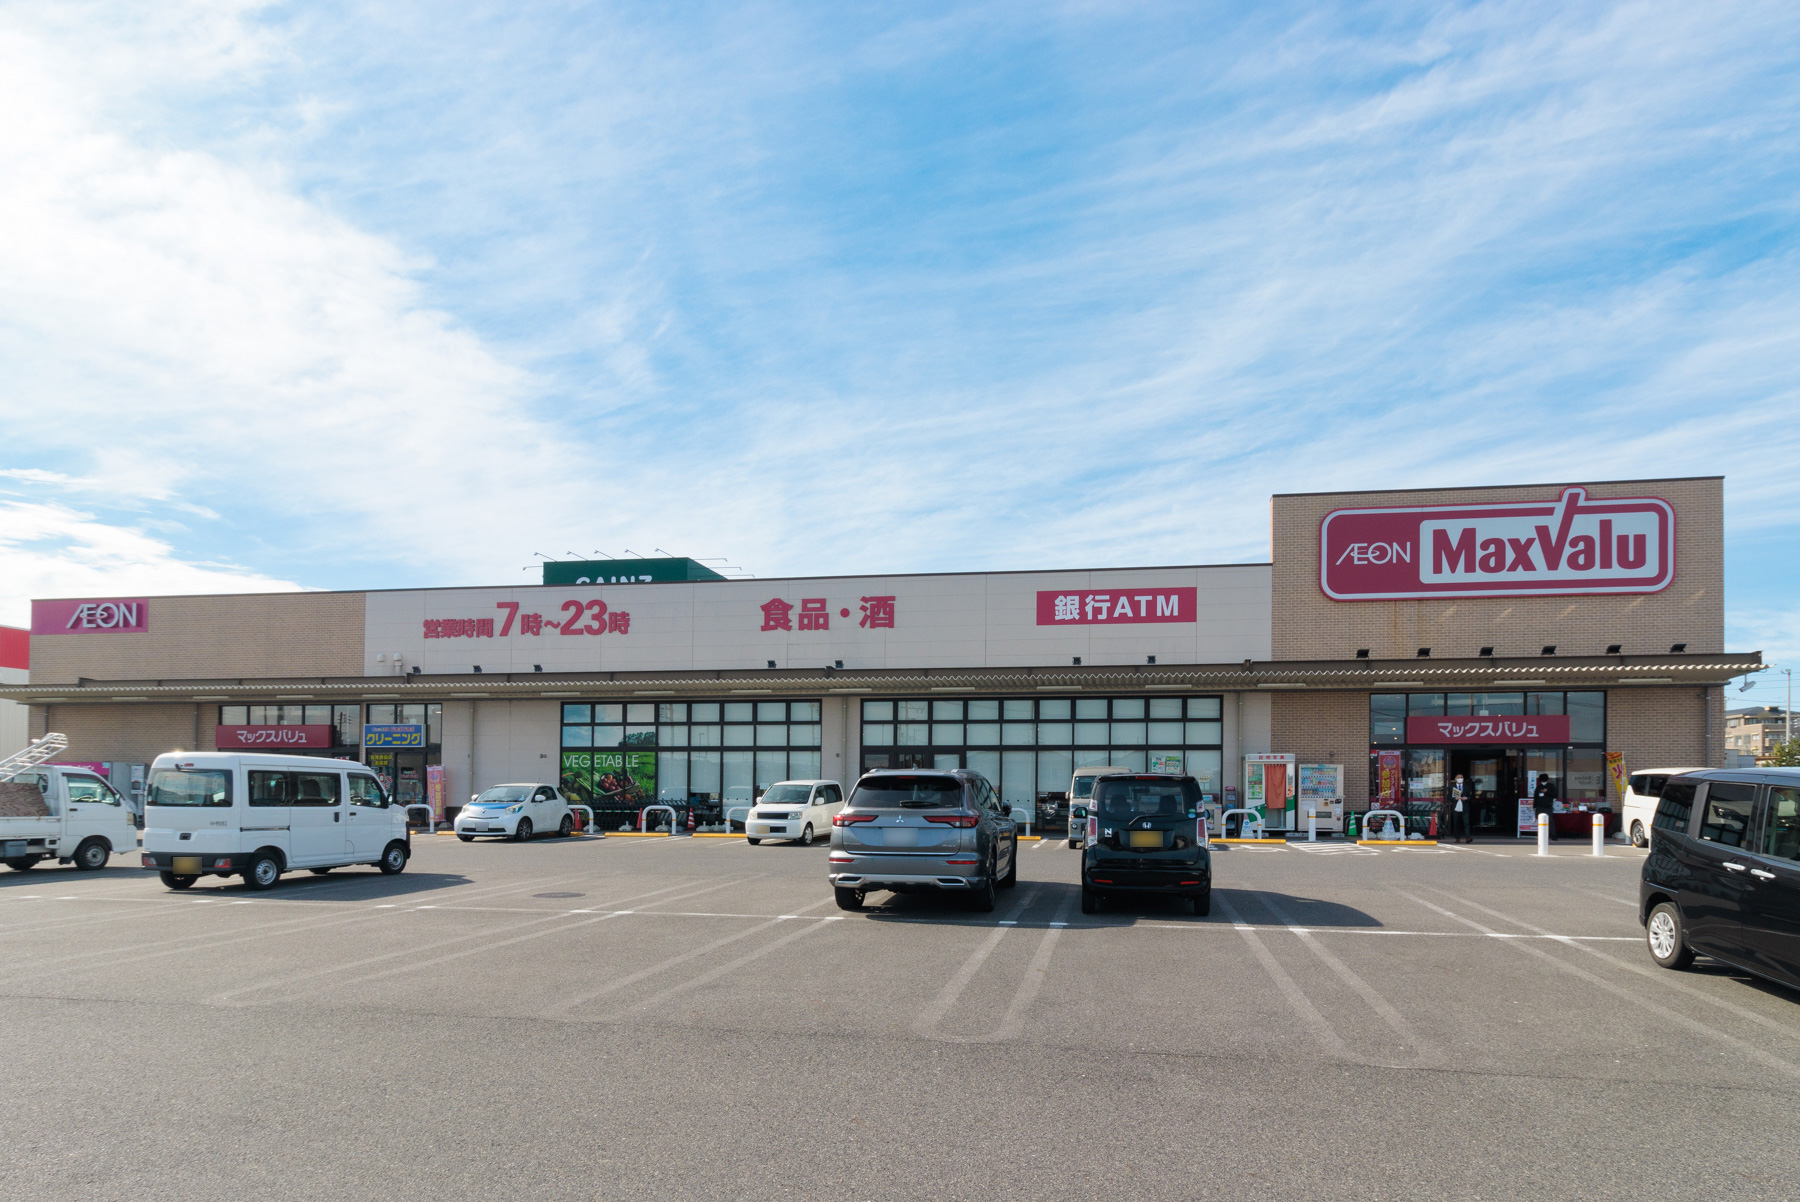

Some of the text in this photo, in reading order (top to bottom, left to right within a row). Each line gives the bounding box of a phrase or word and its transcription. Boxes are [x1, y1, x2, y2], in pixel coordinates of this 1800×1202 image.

[1432, 492, 1647, 575] MaxValu
[1054, 594, 1179, 620] 銀行ATM
[236, 730, 307, 743] マックスバリュ
[1437, 721, 1539, 738] マックスバリュ
[366, 733, 421, 745] クリーニング
[563, 754, 639, 768] VEGETABLE
